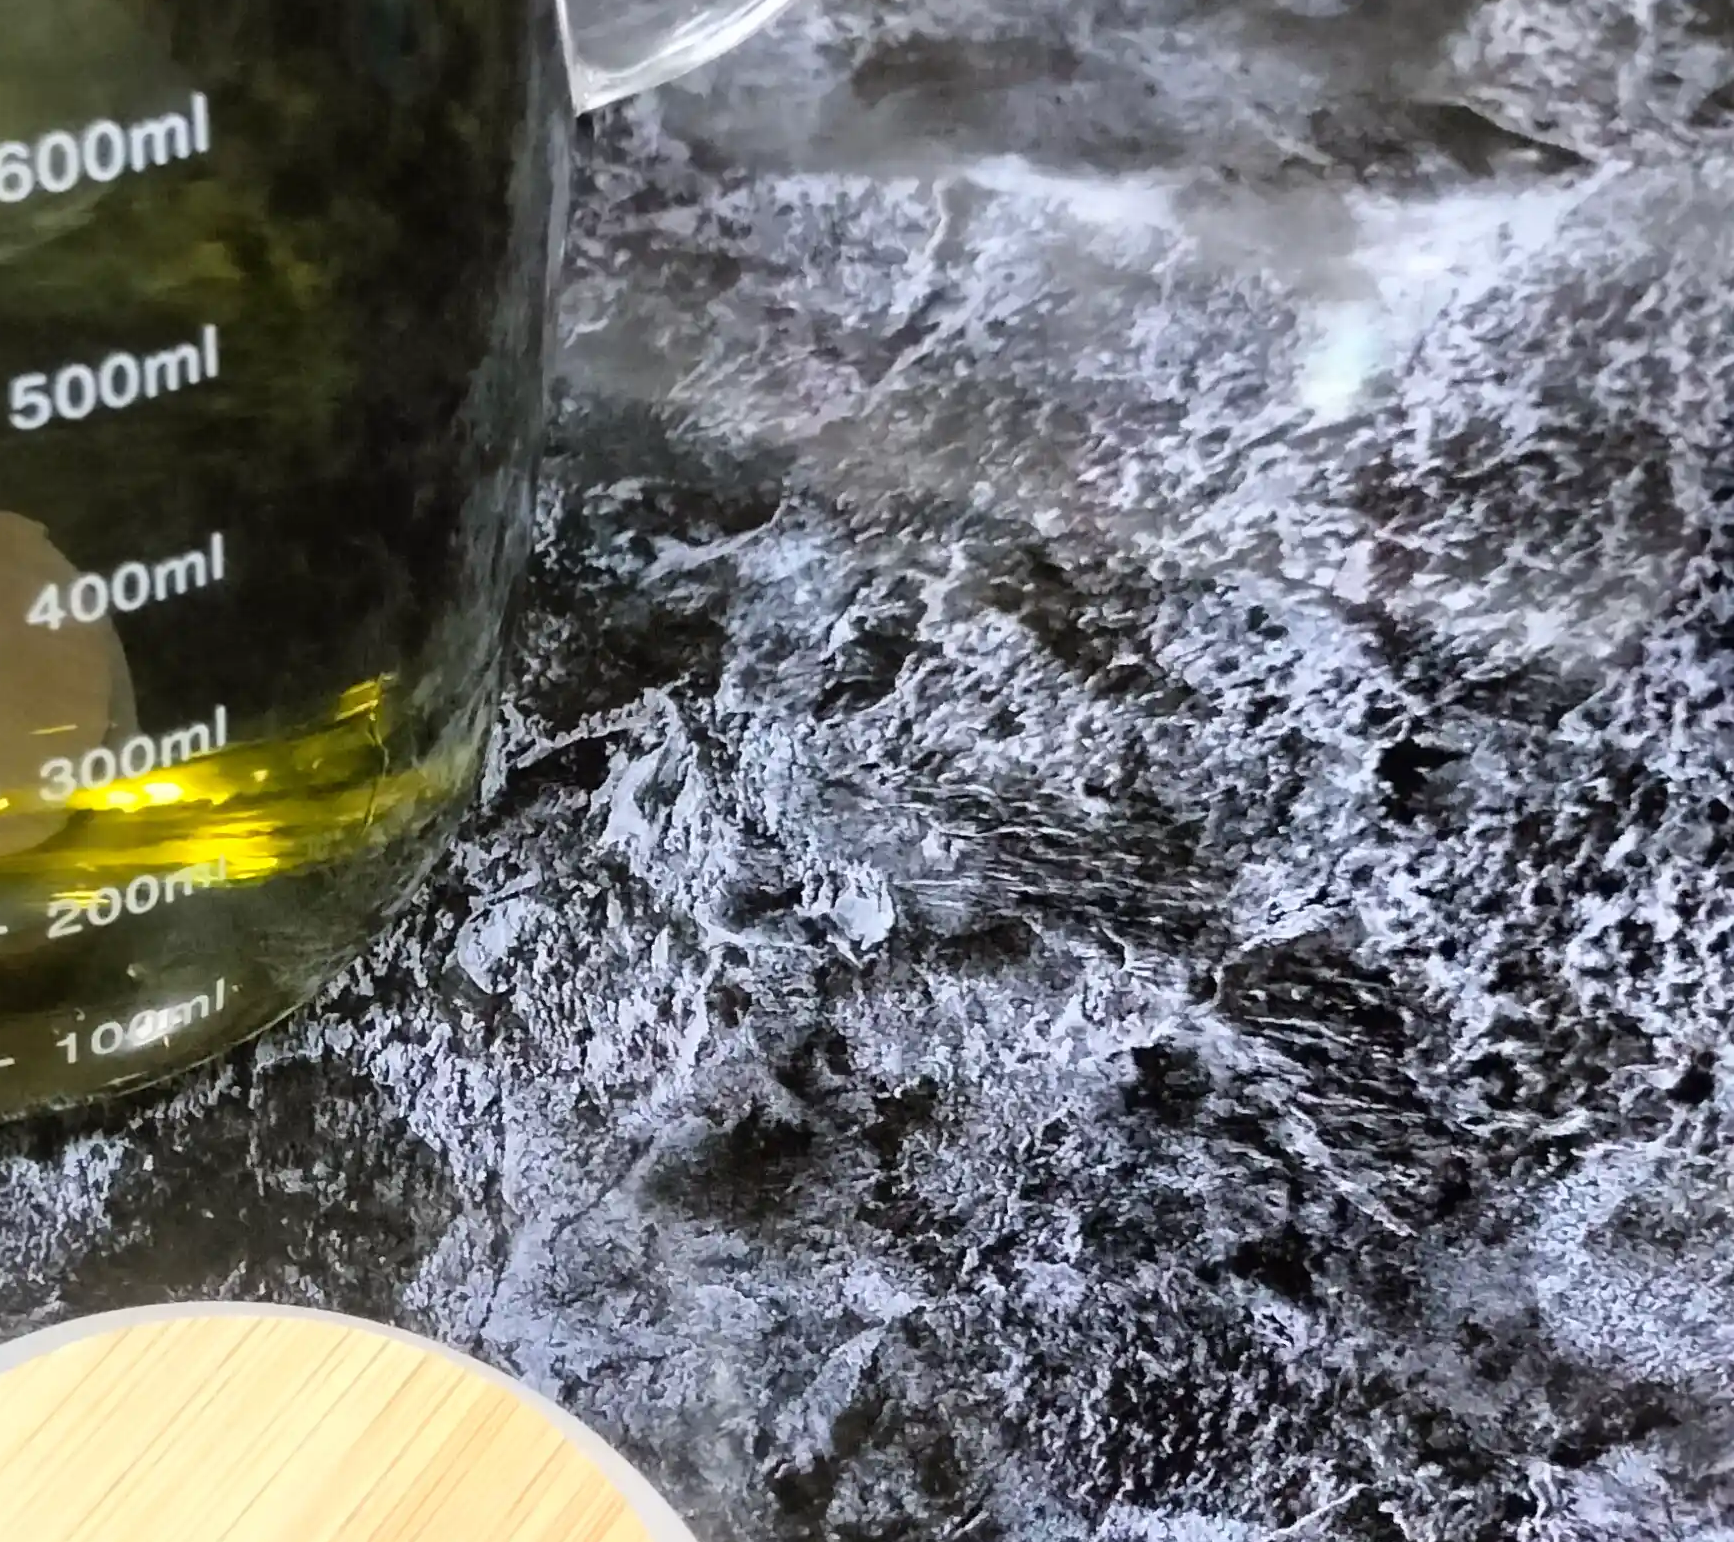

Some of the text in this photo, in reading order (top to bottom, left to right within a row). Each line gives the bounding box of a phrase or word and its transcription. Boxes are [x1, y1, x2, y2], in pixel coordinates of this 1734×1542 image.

[8, 324, 219, 429] 500ml
[26, 532, 225, 630] 400ml
[38, 705, 227, 802] 300ml
[46, 854, 227, 939] 200ml
